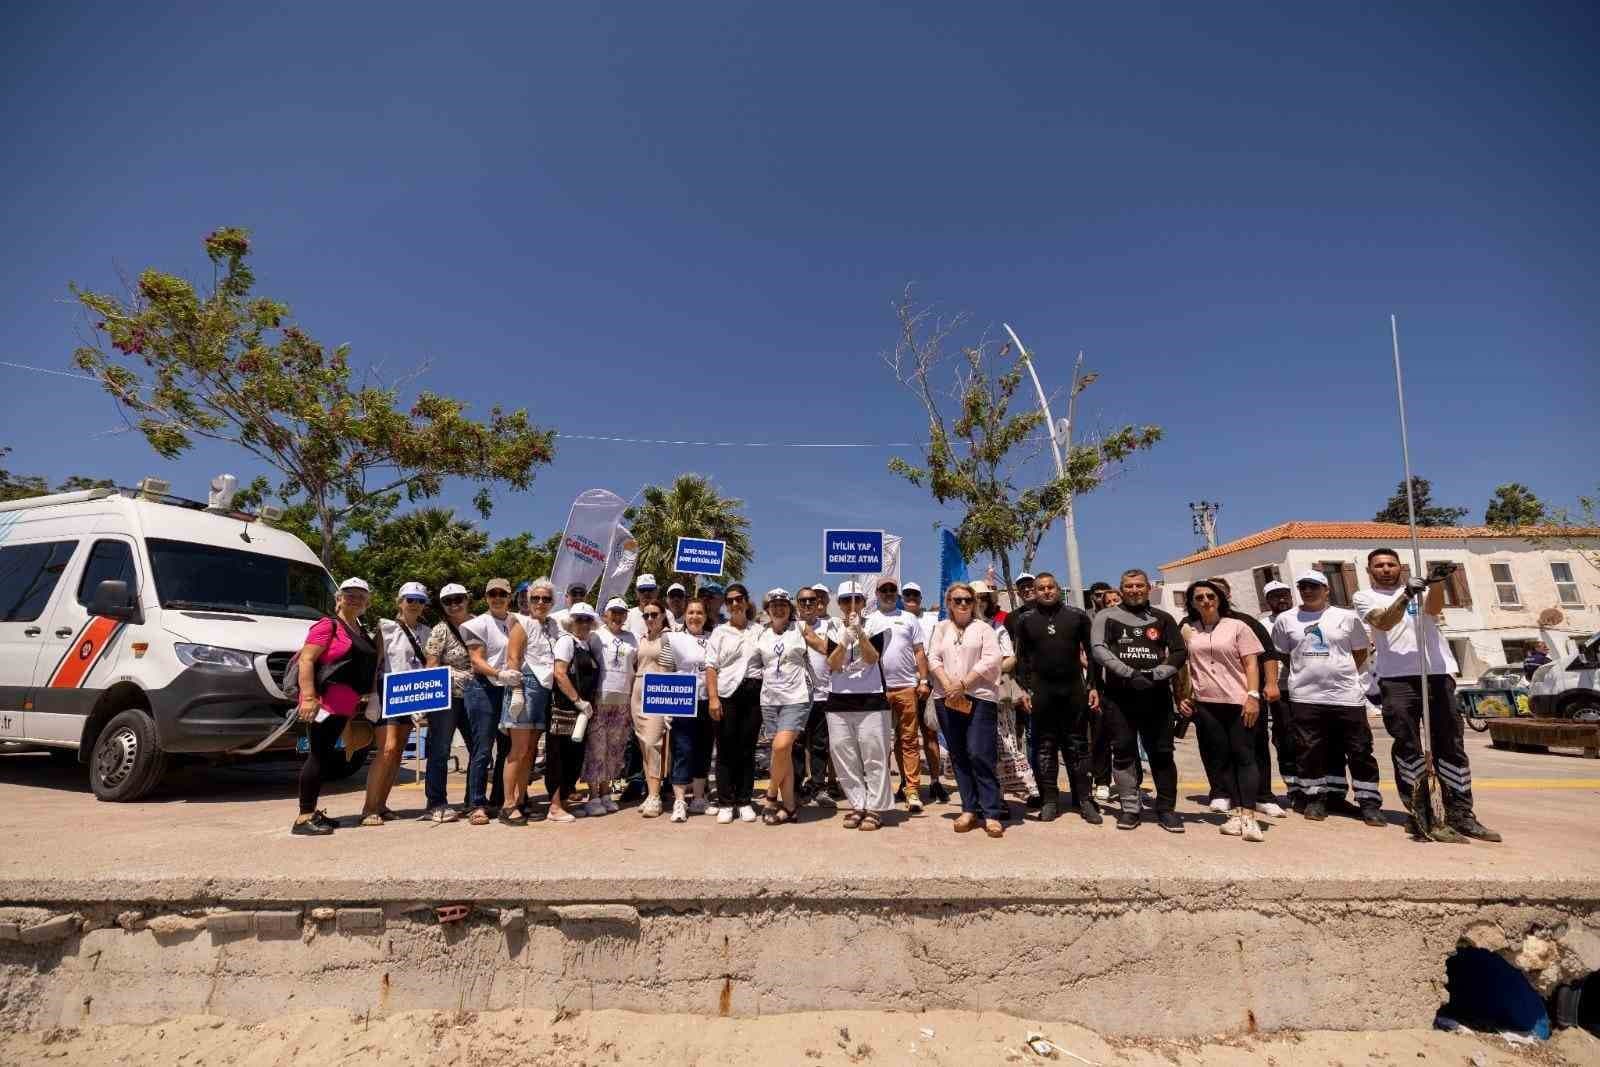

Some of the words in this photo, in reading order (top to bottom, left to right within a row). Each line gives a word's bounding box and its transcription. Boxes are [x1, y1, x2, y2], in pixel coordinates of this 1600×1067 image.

[832, 540, 856, 551] İYİLİK
[829, 553, 857, 563] DENİZE
[857, 555, 879, 563] ATMA
[392, 682, 412, 693] MAVİ
[413, 680, 443, 690] DÜŞÜN,
[646, 683, 693, 694] DENİZLERDEN
[389, 692, 434, 705] GELECEĞİN
[435, 691, 446, 699] OL
[646, 696, 693, 706] SORUMLUYUZ
